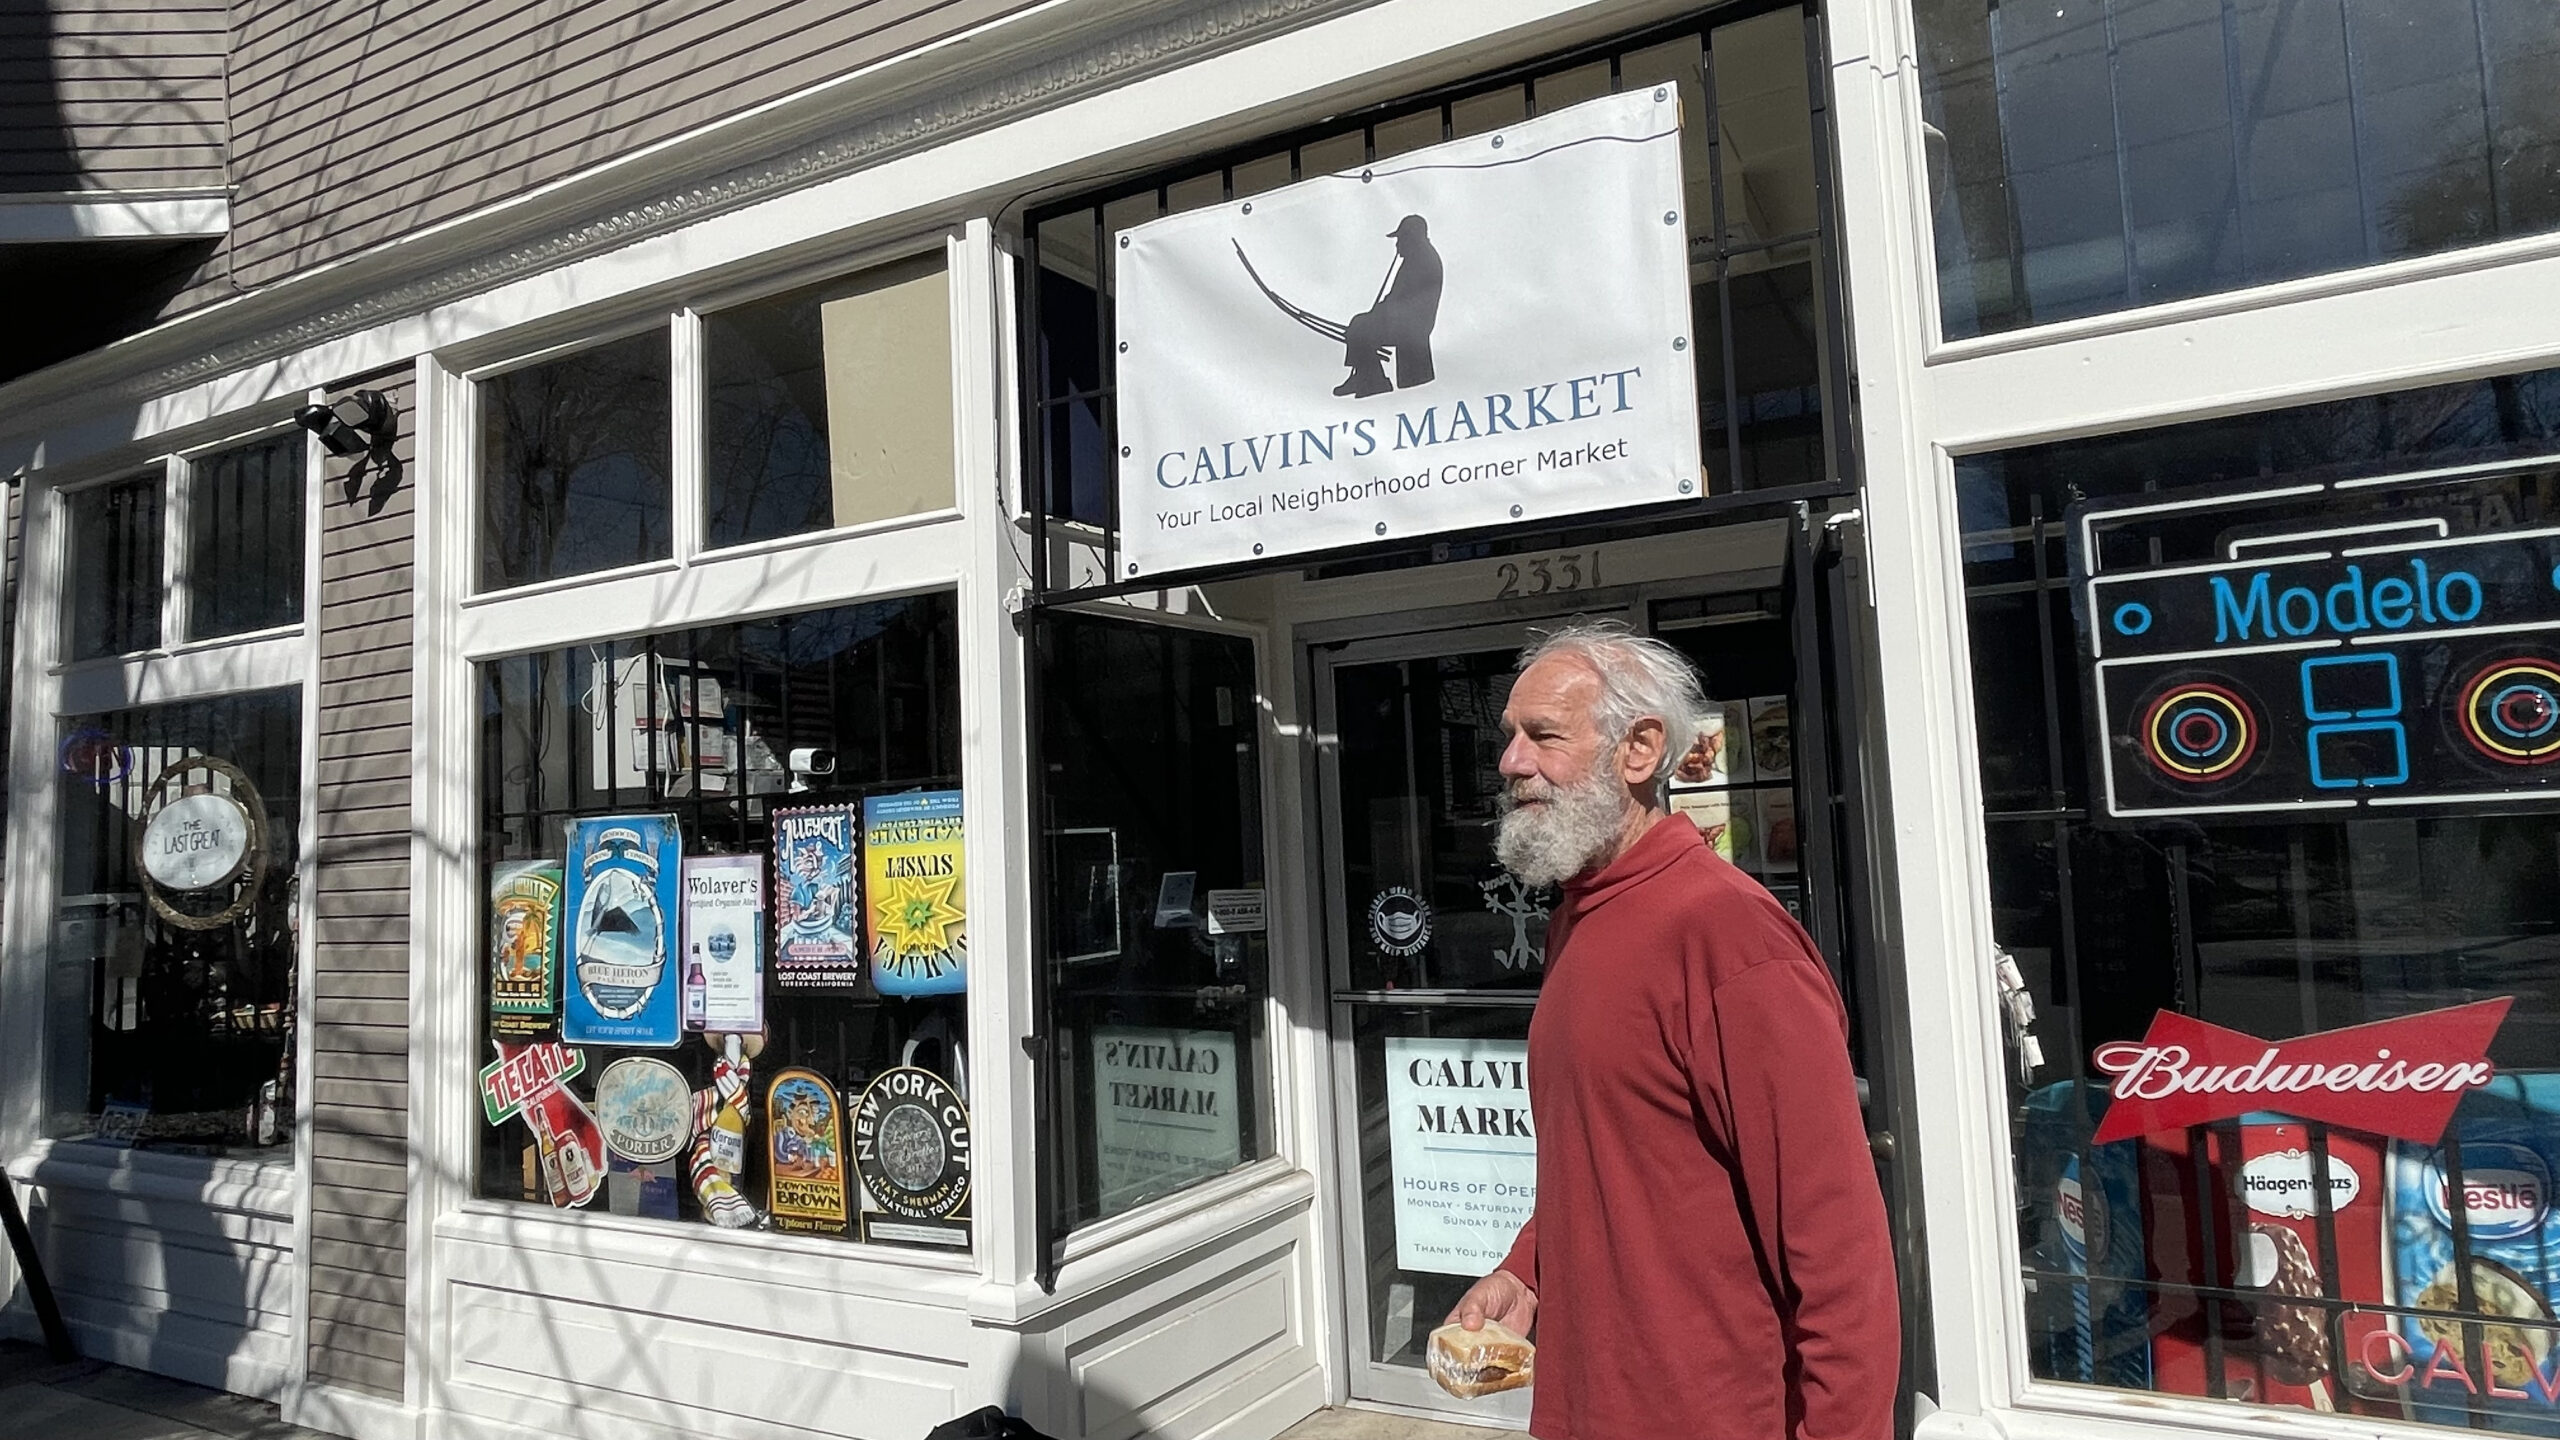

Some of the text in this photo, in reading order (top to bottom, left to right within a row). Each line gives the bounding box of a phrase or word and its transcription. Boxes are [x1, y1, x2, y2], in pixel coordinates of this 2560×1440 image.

[1156, 367, 1642, 489] CALVIN'S MARKET
[1156, 437, 1629, 531] Your Local Neighborhood Corner Market
[1497, 550, 1600, 600] 2331
[2210, 558, 2483, 643] Modelo
[182, 819, 202, 830] THE
[164, 829, 222, 854] LAST GREAT
[885, 853, 953, 878] SUNSET
[688, 877, 758, 894] Wolaver's
[613, 968, 649, 978] HERON
[778, 972, 857, 981] LOST COAST BREWERY
[485, 1042, 578, 1113] TECATE
[1408, 1057, 1525, 1090] CALVI
[2097, 1045, 2489, 1100] Budweiser
[857, 1094, 880, 1161] NEW
[877, 1073, 945, 1109] YORK
[943, 1105, 970, 1171] CUT
[1417, 1105, 1534, 1138] MARK
[616, 1134, 670, 1155] PORTER
[711, 1126, 742, 1148] Corona
[776, 1181, 840, 1194] DOWNTOWN
[865, 1175, 966, 1218] ALL-NATURAL TOBACCO
[879, 1177, 950, 1207] NAT SHERMAN
[1403, 1177, 1461, 1193] HOURS
[1467, 1183, 1488, 1194] OF
[2243, 1174, 2353, 1195] Häagen-azs
[776, 1191, 841, 1209] BROWN
[1407, 1198, 1453, 1209] MONDAY
[1464, 1202, 1524, 1215] SATURDAY
[1443, 1215, 1488, 1228] SUNDAY
[1504, 1220, 1522, 1230] AM
[1414, 1243, 1503, 1260] THANK YOU FOR
[2362, 1329, 2560, 1404] CALV
